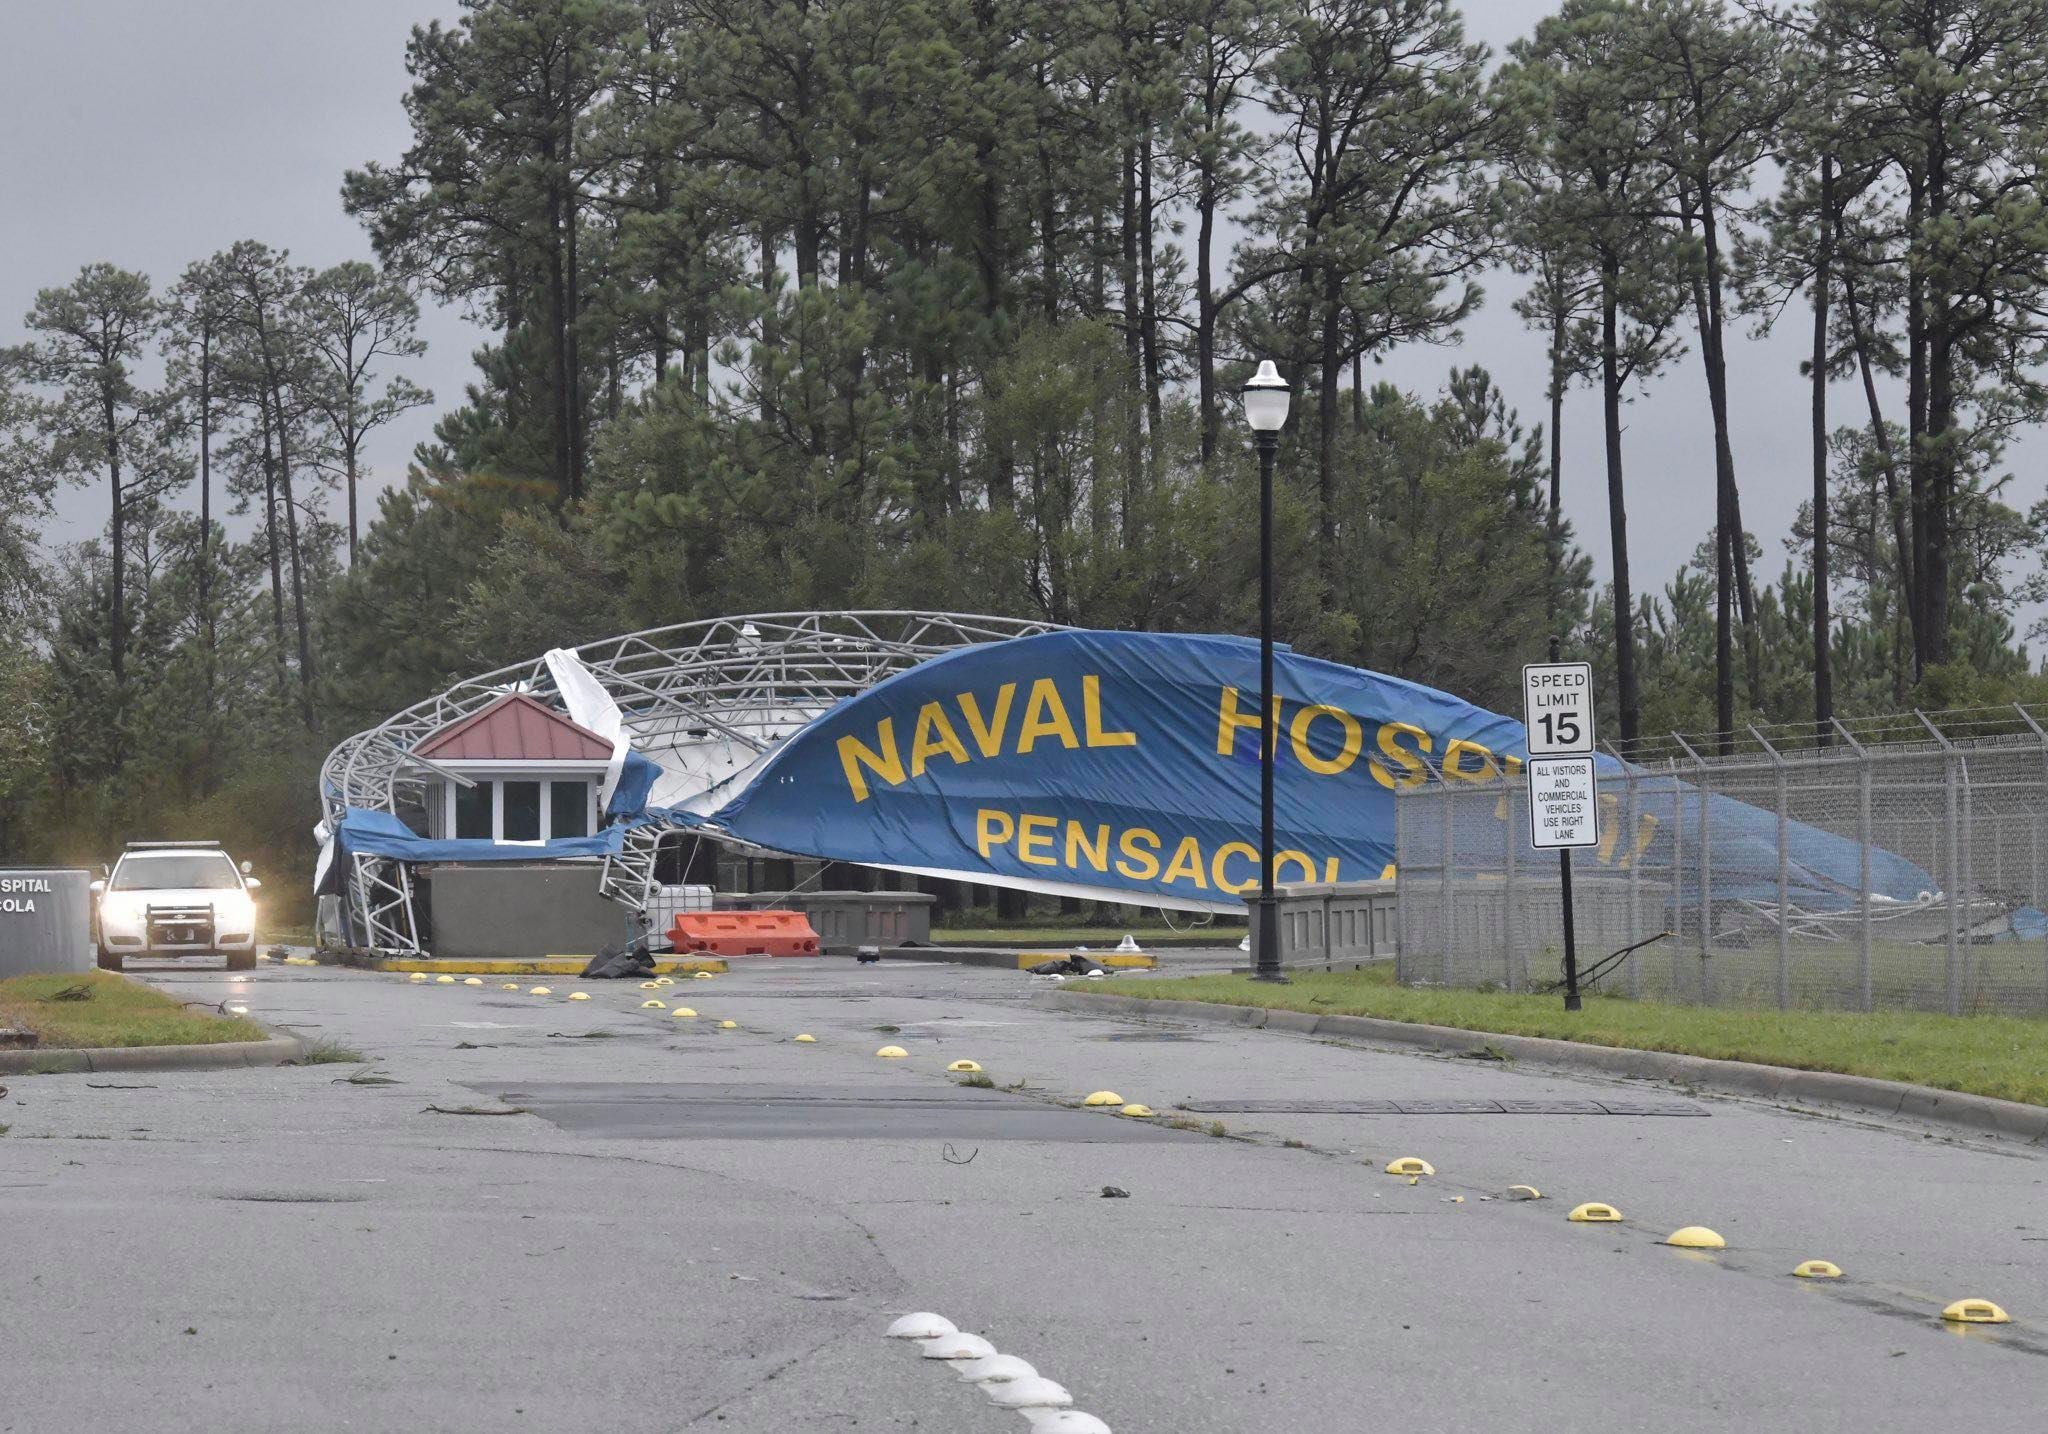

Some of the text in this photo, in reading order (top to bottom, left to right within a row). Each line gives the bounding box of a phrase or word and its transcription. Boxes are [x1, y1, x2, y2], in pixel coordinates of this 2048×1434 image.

[1530, 674, 1585, 688] SPEED
[1536, 693, 1580, 707] LIMIT
[1537, 712, 1581, 745] 15
[836, 674, 1137, 803] NAVAL
[1536, 766, 1550, 777] ALL
[1554, 778, 1570, 788] AND
[1537, 790, 1588, 802] COMMERCIAL
[1545, 804, 1582, 814] VEHICLES
[1543, 816, 1584, 828] USE RIGHT
[1554, 829, 1575, 840] LANE
[0, 879, 52, 892] SPITAL
[0, 899, 35, 912] OLA
